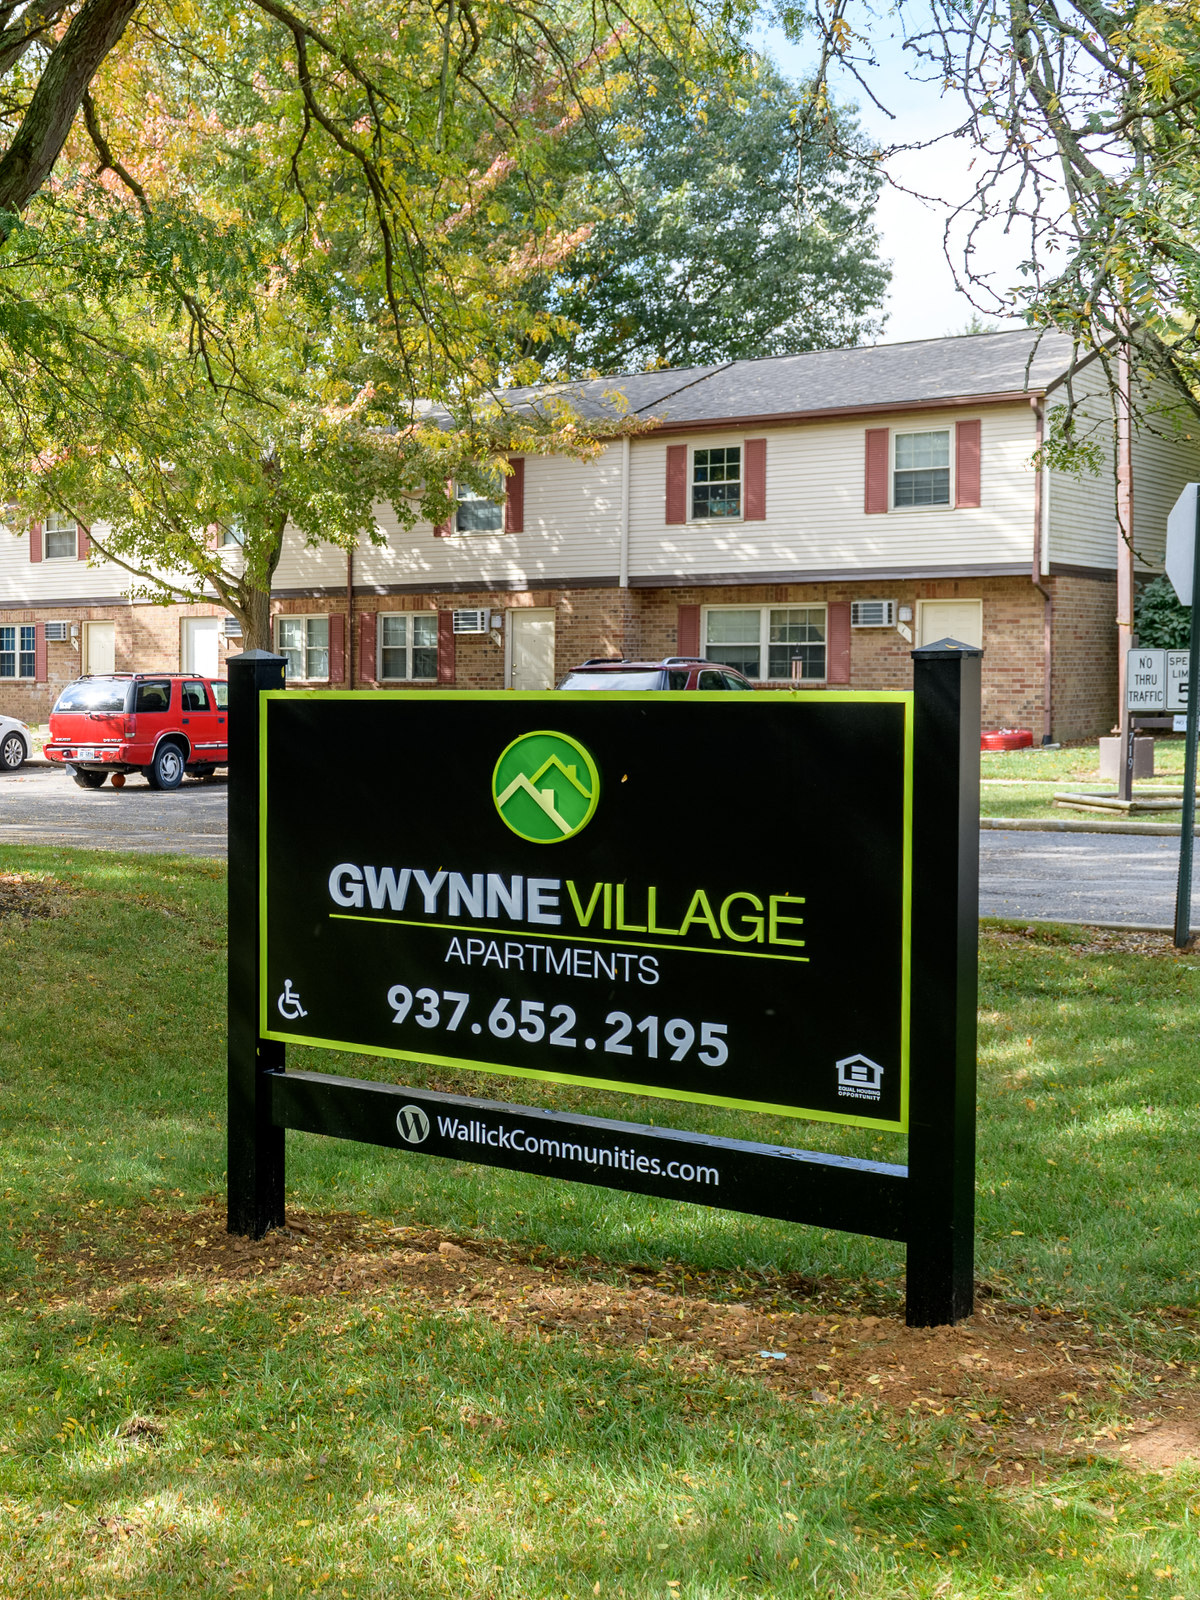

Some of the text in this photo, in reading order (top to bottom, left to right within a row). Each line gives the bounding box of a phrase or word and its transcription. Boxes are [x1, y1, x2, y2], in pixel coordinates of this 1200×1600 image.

[1139, 657, 1153, 669] NO
[1169, 656, 1188, 666] SPE
[1135, 674, 1158, 686] THRU
[1172, 670, 1189, 679] LIM
[1128, 690, 1163, 702] TRAFFIC
[328, 862, 806, 947] GWYNNE VILLAGE
[444, 936, 660, 985] APARTMENTS
[387, 983, 729, 1067] 937.652.2195
[838, 1085, 881, 1096] EQUAL HOUSING
[838, 1090, 881, 1101] OPPORTUNITY
[437, 1115, 720, 1186] WallickCommunities.com
